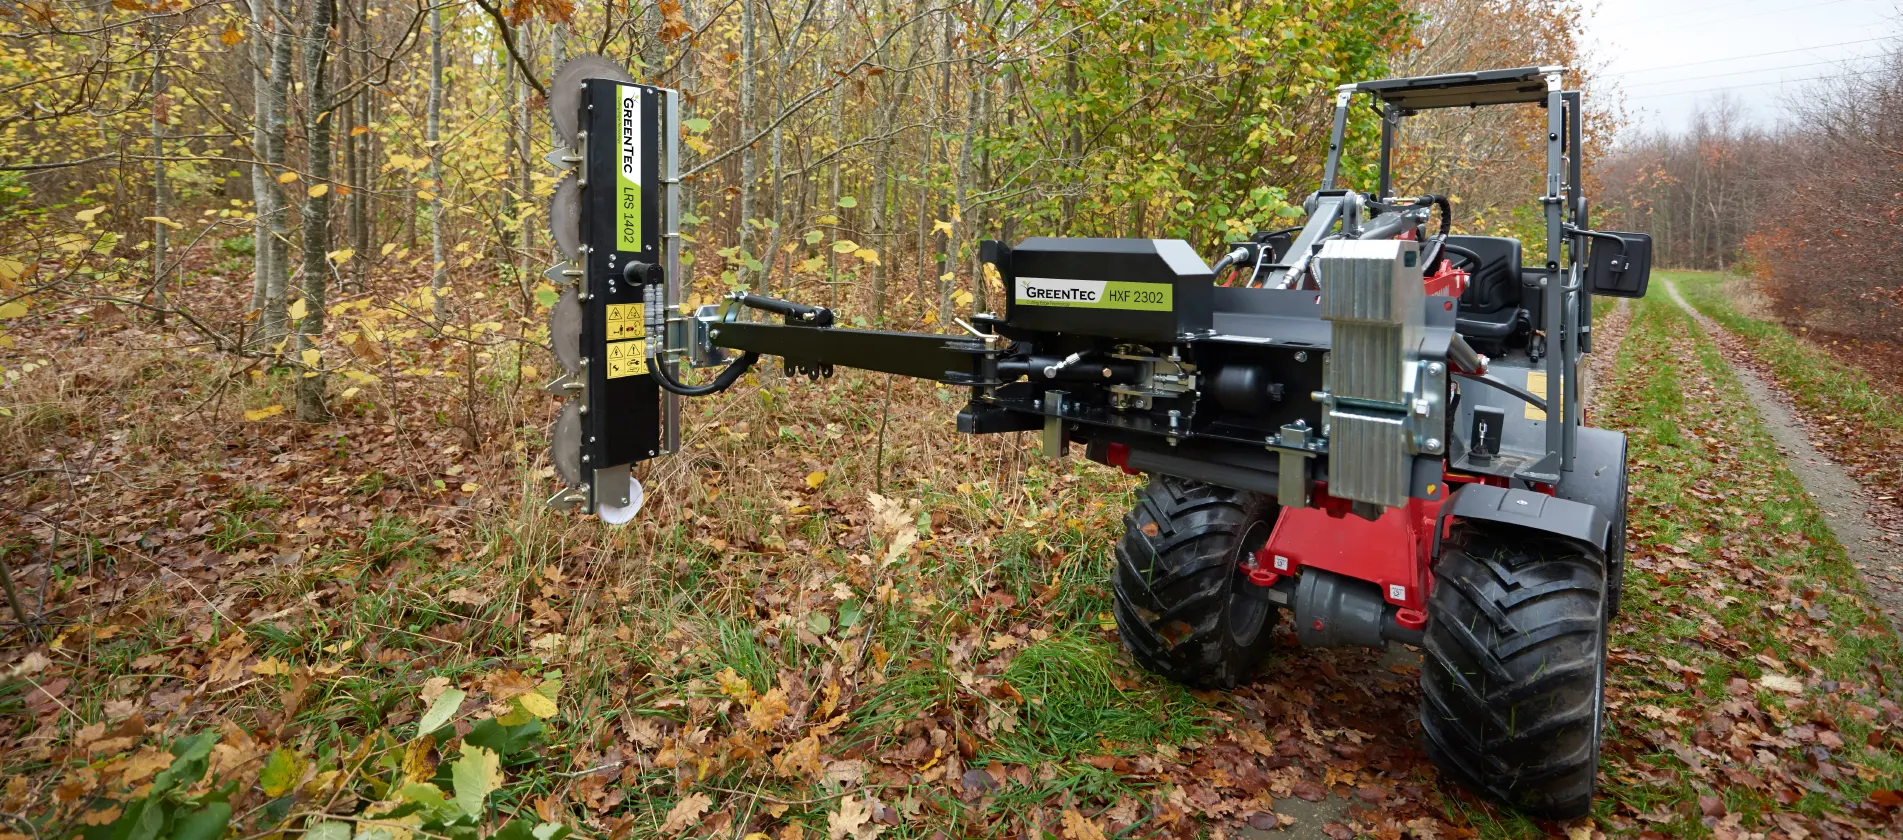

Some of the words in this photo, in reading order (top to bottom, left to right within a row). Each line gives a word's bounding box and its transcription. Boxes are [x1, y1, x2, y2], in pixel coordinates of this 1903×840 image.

[623, 187, 634, 210] LRS
[624, 213, 635, 243] 1402
[1109, 290, 1130, 302] HXF
[1133, 290, 1164, 304] 2302
